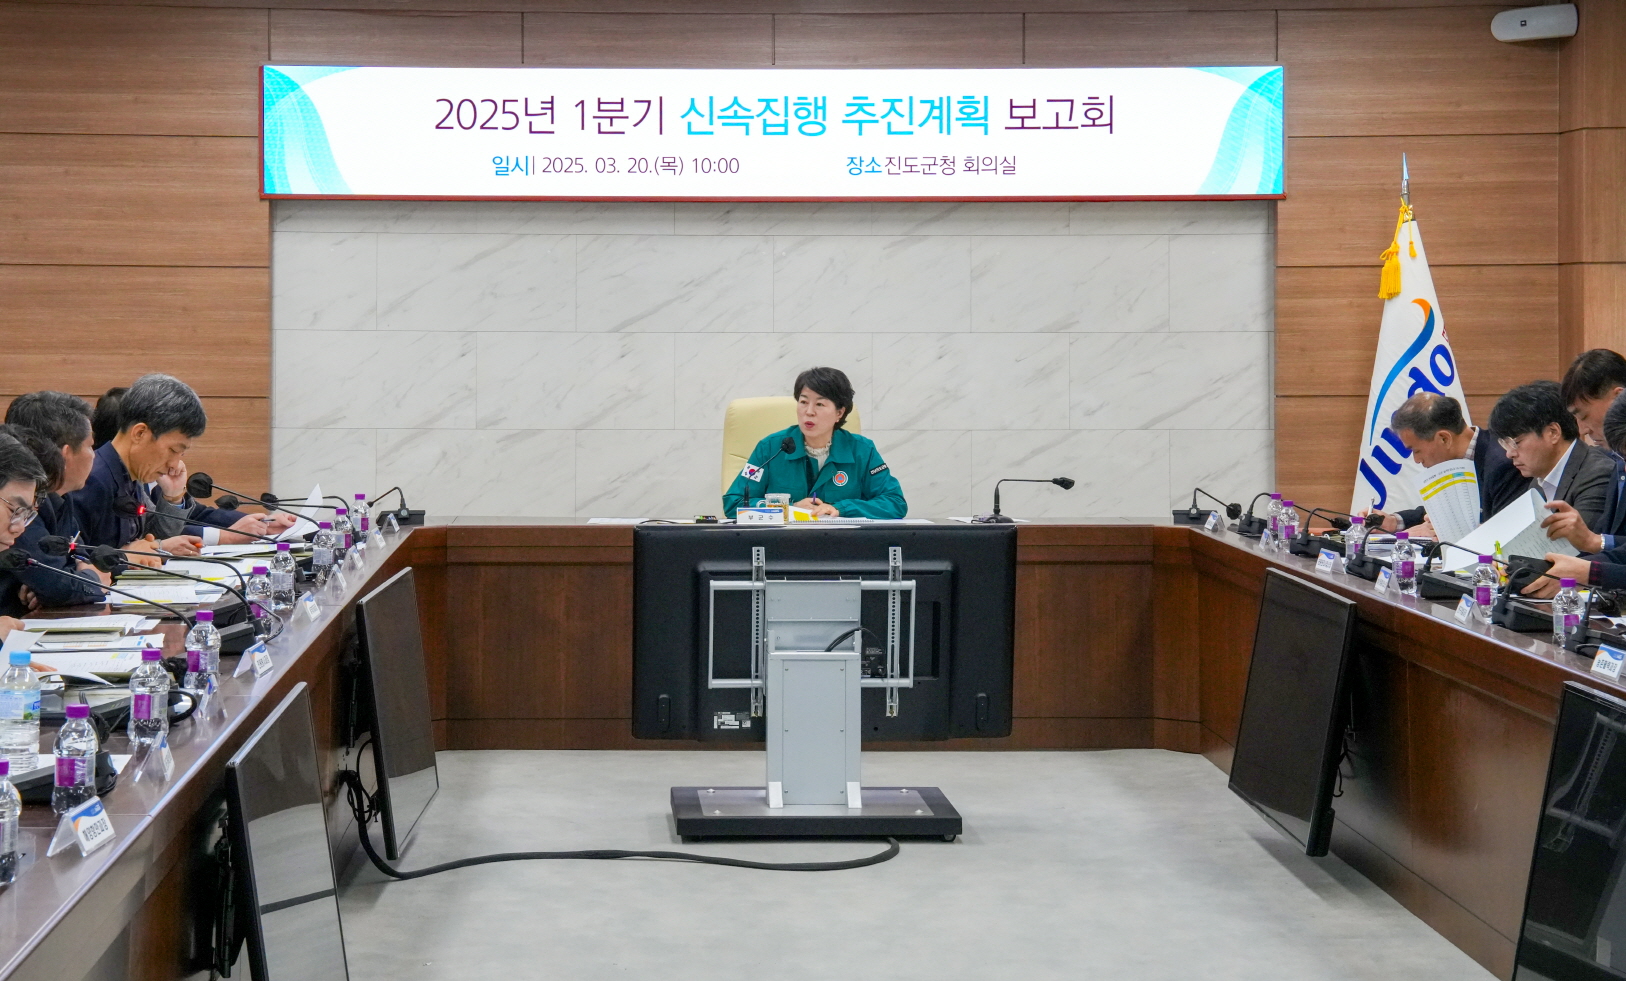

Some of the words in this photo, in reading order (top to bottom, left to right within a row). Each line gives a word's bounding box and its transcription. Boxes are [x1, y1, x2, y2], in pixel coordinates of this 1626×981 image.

[435, 96, 555, 135] 2025년
[575, 95, 664, 136] 1분기
[680, 95, 827, 137] 신속집행
[842, 95, 989, 137] 추진계획
[1005, 95, 1115, 135] 보고회
[542, 157, 587, 174] 2025.
[595, 157, 620, 174] 03.
[628, 156, 684, 176] 20.(목)
[692, 157, 740, 174] 10:00
[963, 155, 1017, 176] 회의실
